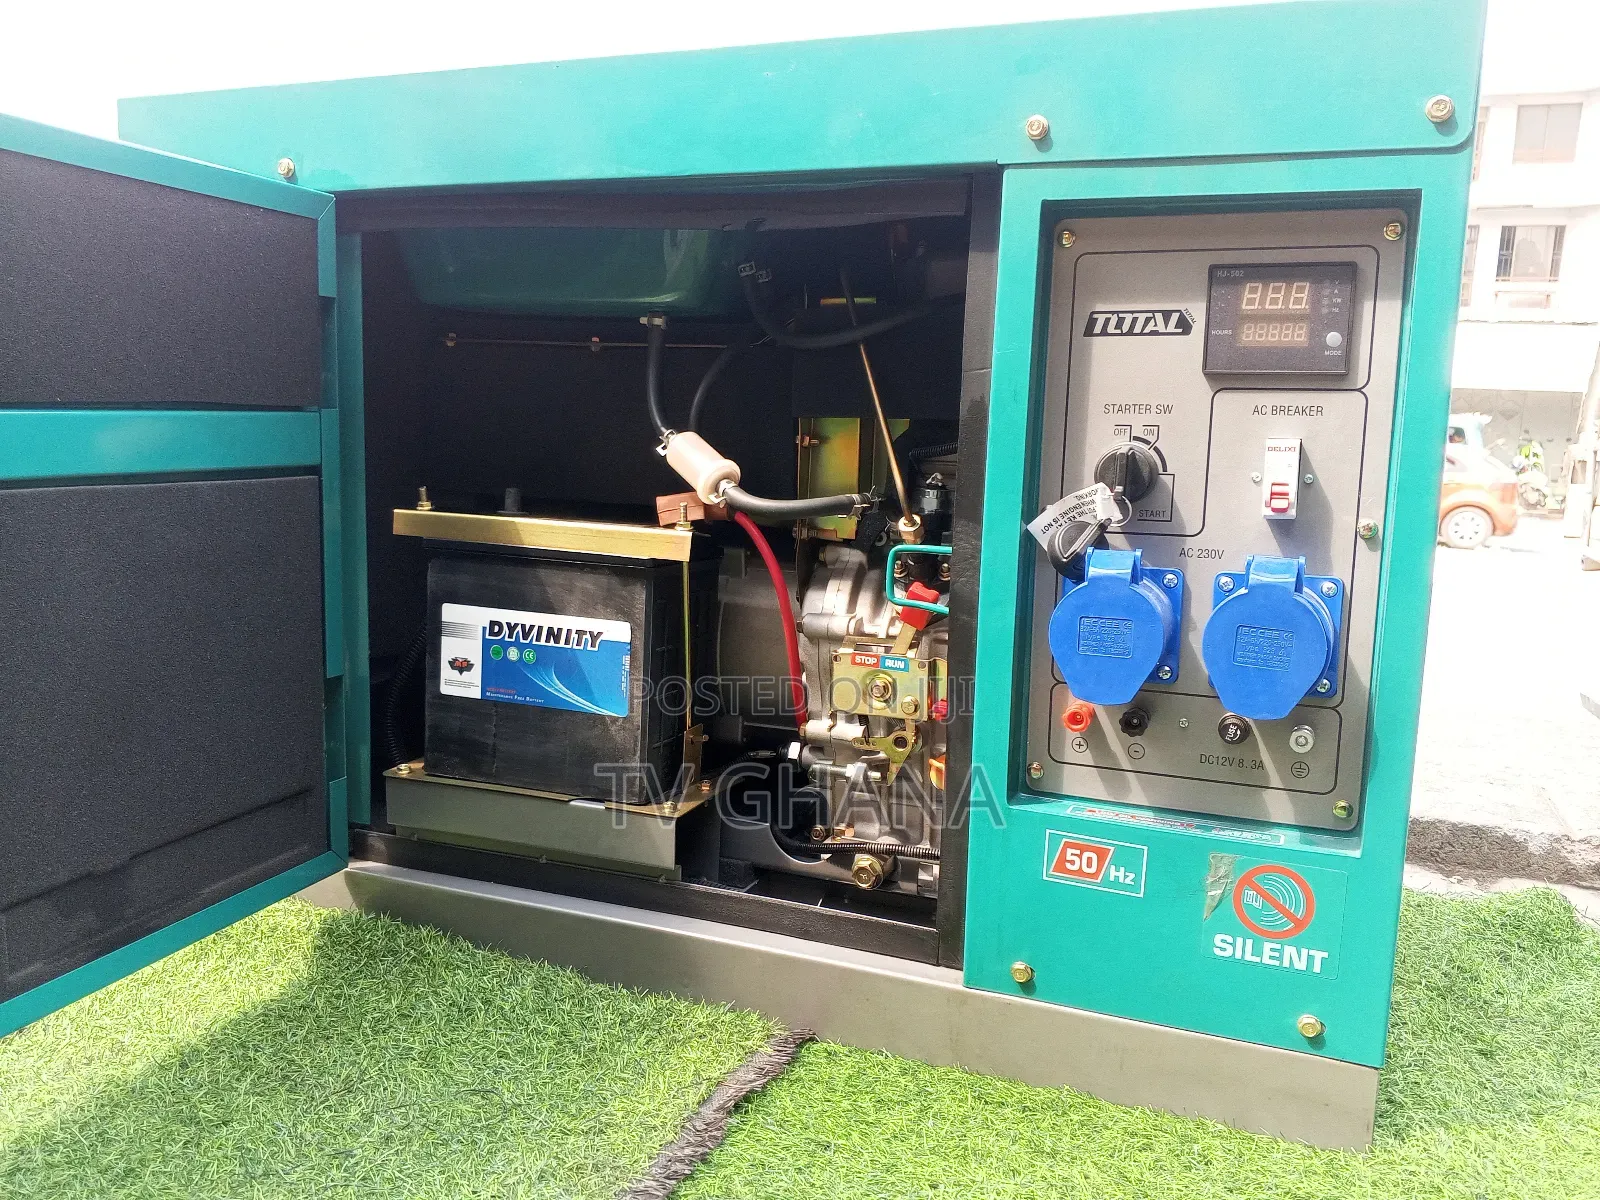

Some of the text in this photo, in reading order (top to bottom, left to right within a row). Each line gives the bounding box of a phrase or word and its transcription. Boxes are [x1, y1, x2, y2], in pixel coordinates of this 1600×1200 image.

[1092, 312, 1184, 334] TOTAL
[1103, 403, 1174, 415] STARTER SW
[1252, 404, 1324, 417] AC BREAKER
[1113, 428, 1128, 437] OFF
[1143, 428, 1155, 437] ON
[1138, 509, 1167, 518] START
[1041, 522, 1054, 535] NOT
[1179, 547, 1225, 560] AC 230V
[488, 620, 603, 648] DYVINITY
[855, 655, 878, 666] STOP
[885, 658, 905, 669] RUN
[1225, 723, 1238, 742] FUSE
[1199, 753, 1236, 767] DC12V
[1064, 847, 1137, 886] 50 Hz
[1212, 933, 1329, 975] SILENT
